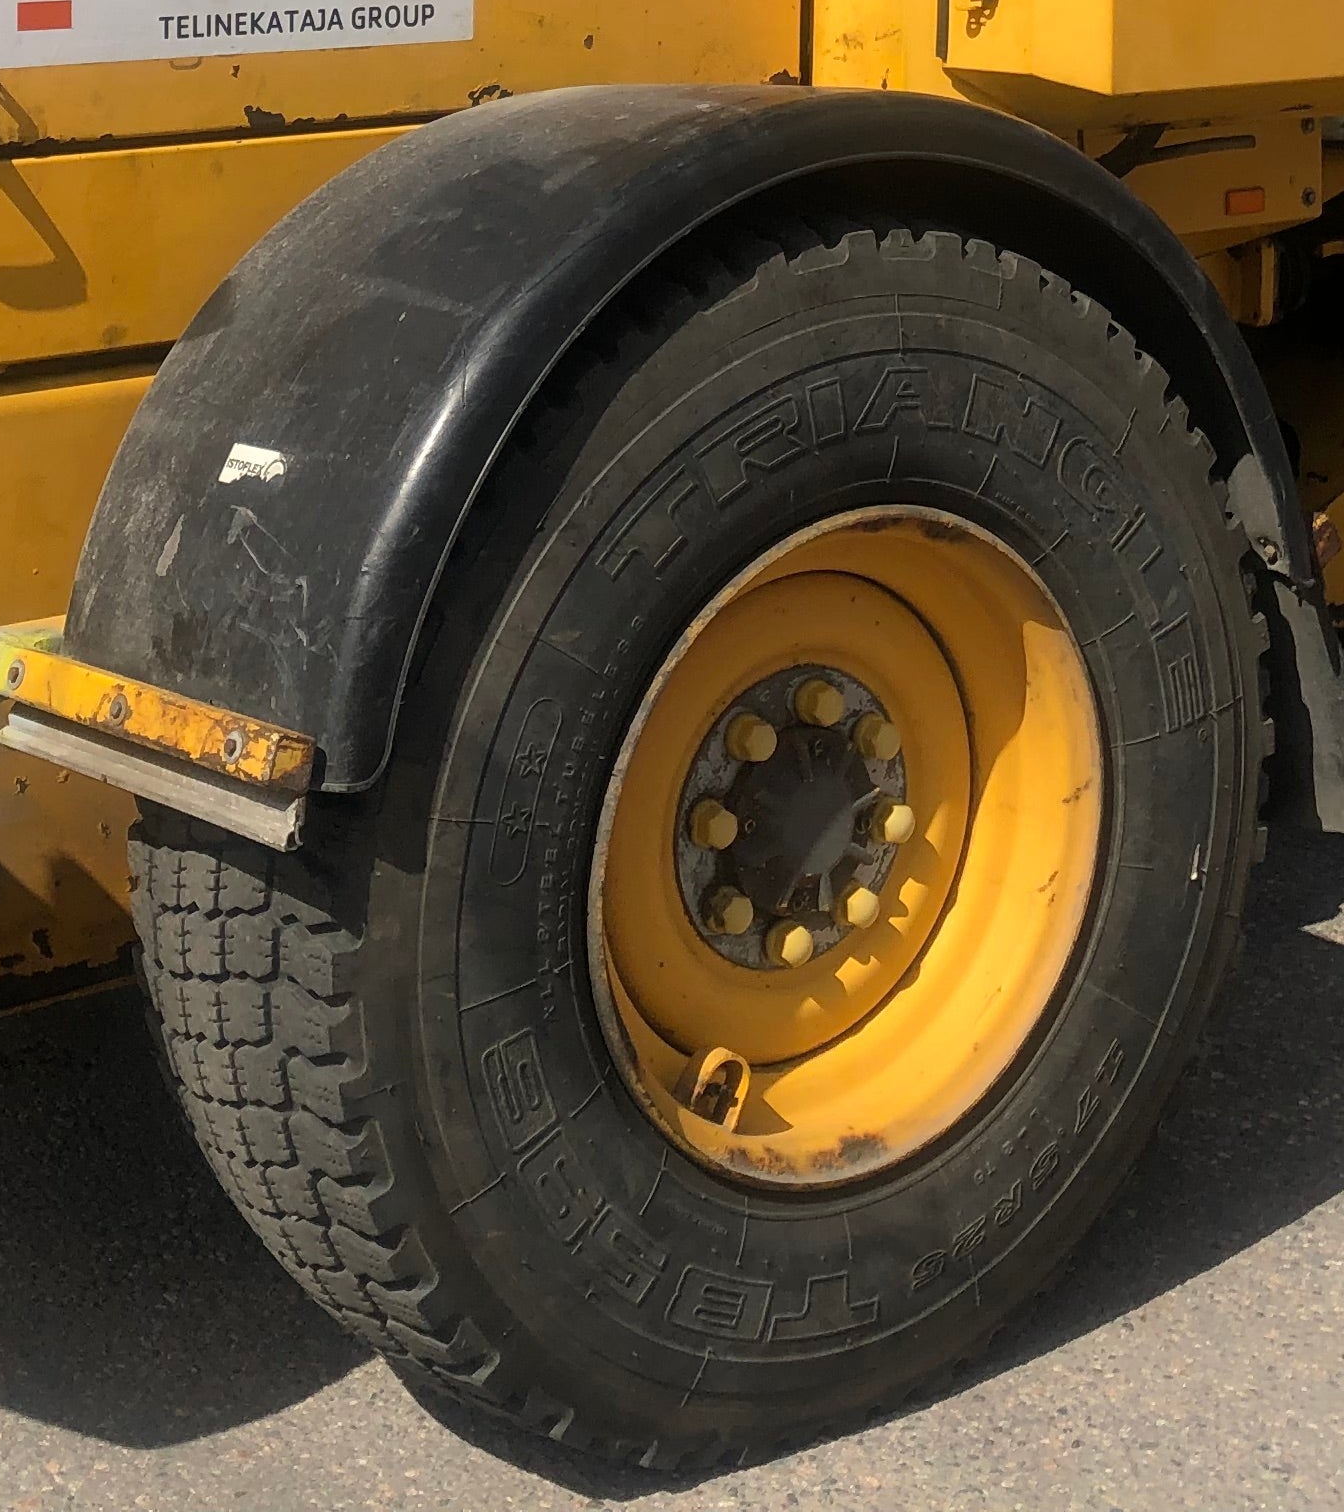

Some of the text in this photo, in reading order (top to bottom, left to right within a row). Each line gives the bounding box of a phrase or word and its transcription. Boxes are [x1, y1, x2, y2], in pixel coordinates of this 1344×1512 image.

[158, 3, 435, 40] TELINEKATAJA GROUP
[595, 367, 1210, 735] TRIANGLE
